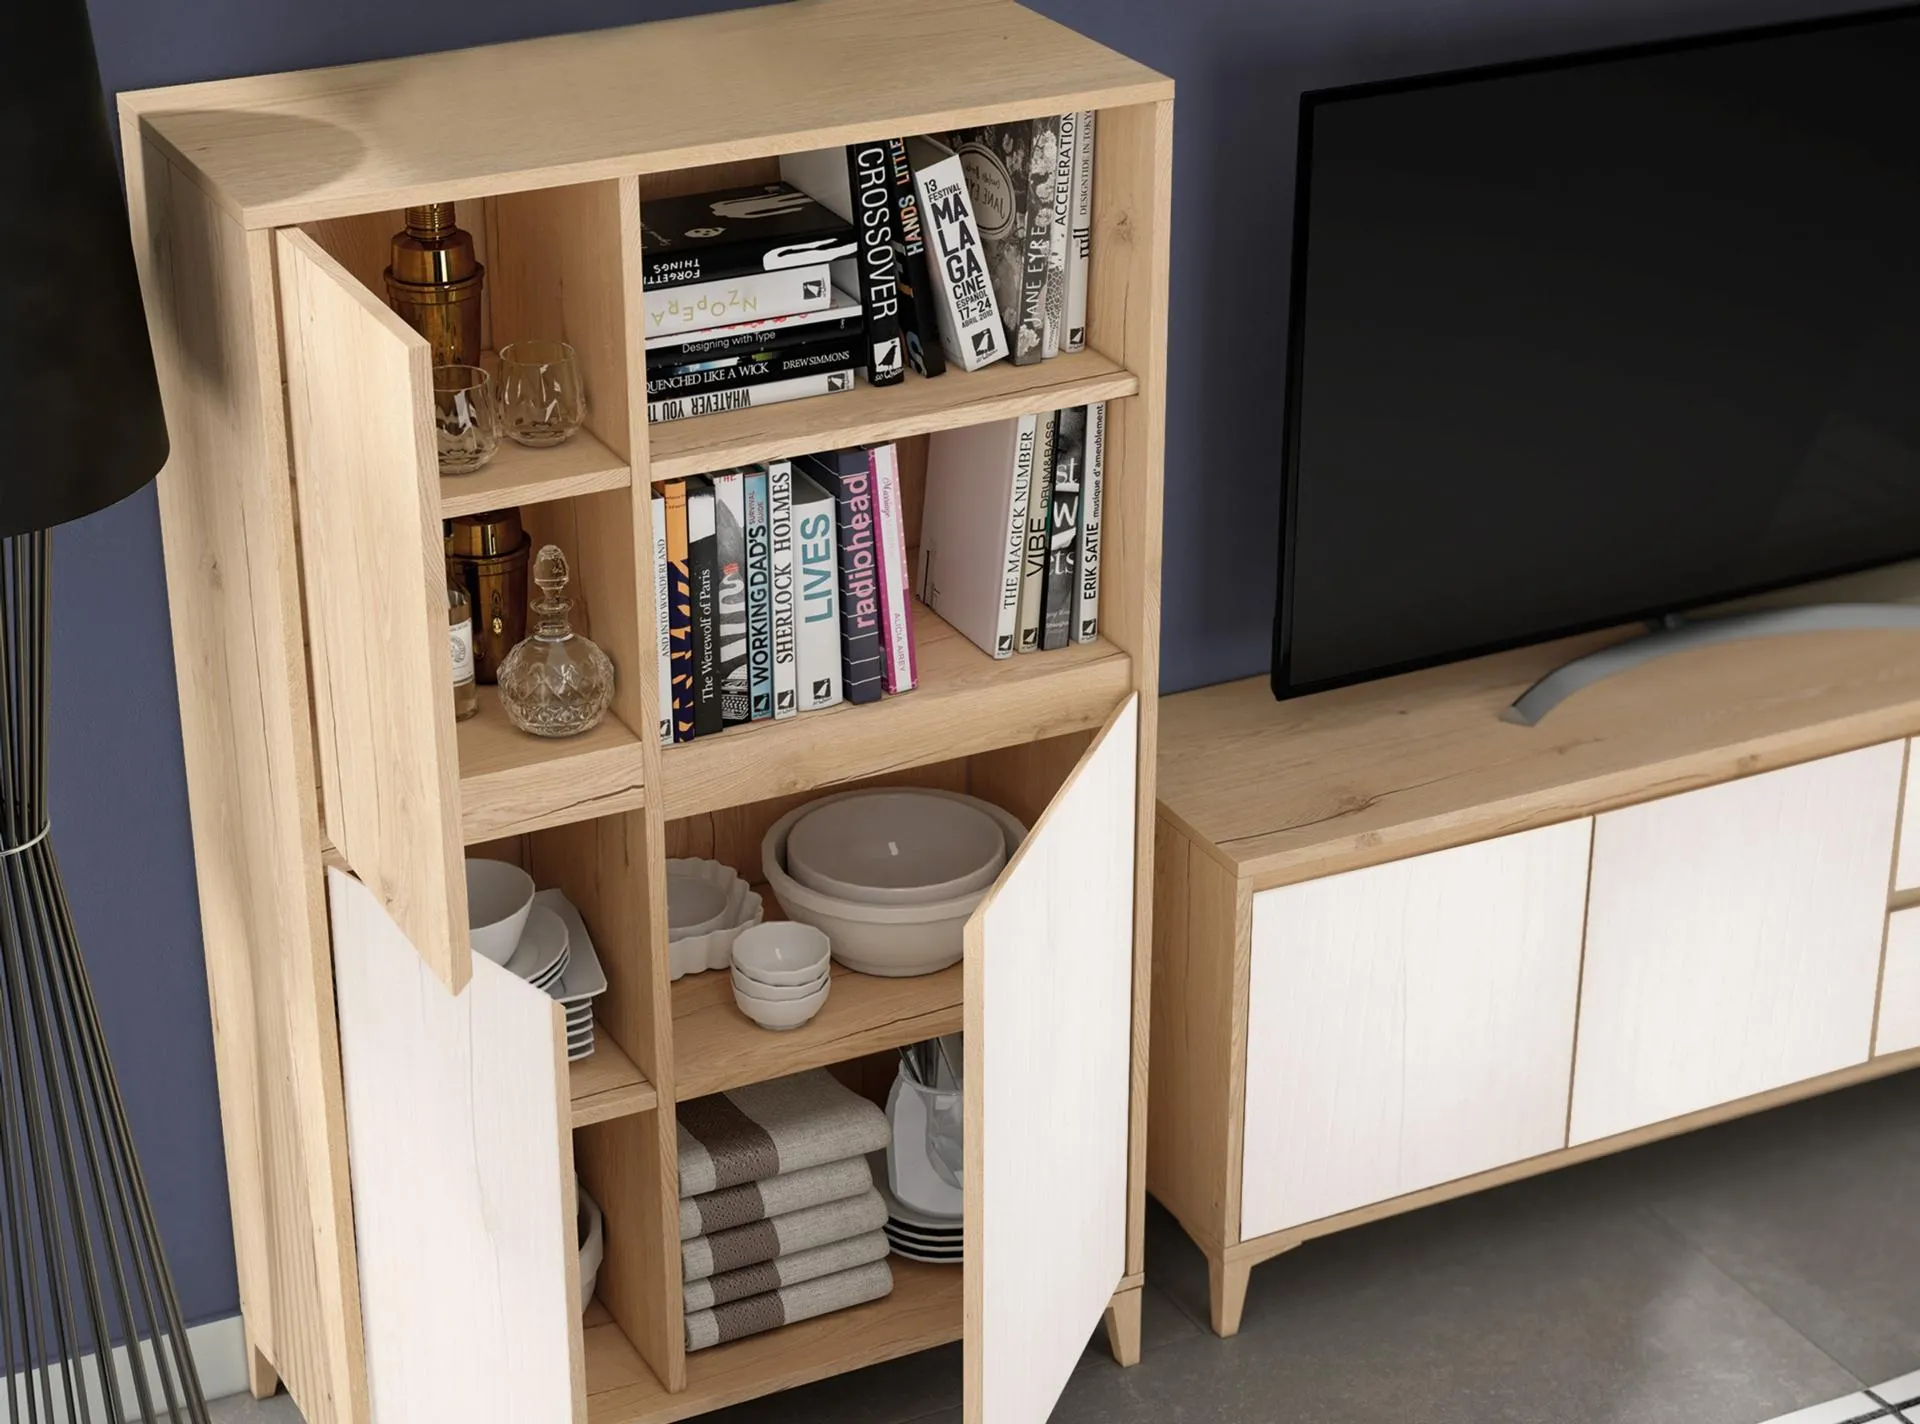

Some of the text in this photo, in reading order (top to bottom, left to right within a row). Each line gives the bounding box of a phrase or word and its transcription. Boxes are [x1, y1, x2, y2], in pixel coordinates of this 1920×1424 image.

[1082, 144, 1090, 154] IN
[924, 179, 937, 194] 13
[1055, 112, 1074, 226] ACCELERATION
[890, 137, 924, 256] HANDS LITTLE
[928, 183, 961, 203] FESTIVAL
[857, 148, 898, 320] CROSSOVER
[938, 220, 976, 257] LA
[653, 258, 700, 274] THINGS
[945, 247, 983, 284] GA
[1023, 226, 1050, 327] JANE EYRE
[952, 274, 986, 300] CINE
[956, 289, 988, 310] ESPAÑOL
[961, 315, 979, 329] ABRIL
[682, 330, 776, 354] Designing with Type
[704, 369, 725, 383] LIKE
[727, 369, 738, 380] A
[740, 362, 770, 378] WICK
[783, 350, 850, 371] DREW SIMMONS
[663, 399, 685, 420] YOU
[691, 388, 751, 416] WHATEVER
[1092, 482, 1101, 518] musique
[1003, 431, 1033, 610] THE MAGICK NUMBER
[843, 474, 877, 628] radiohead
[1026, 517, 1047, 577] VIBE
[1084, 522, 1099, 563] SATIE
[772, 472, 794, 664] SHERLOCK HOLMES
[800, 513, 833, 623] LIVES
[1083, 567, 1097, 600] ERIK
[699, 568, 713, 703] The Werewolf of Paris
